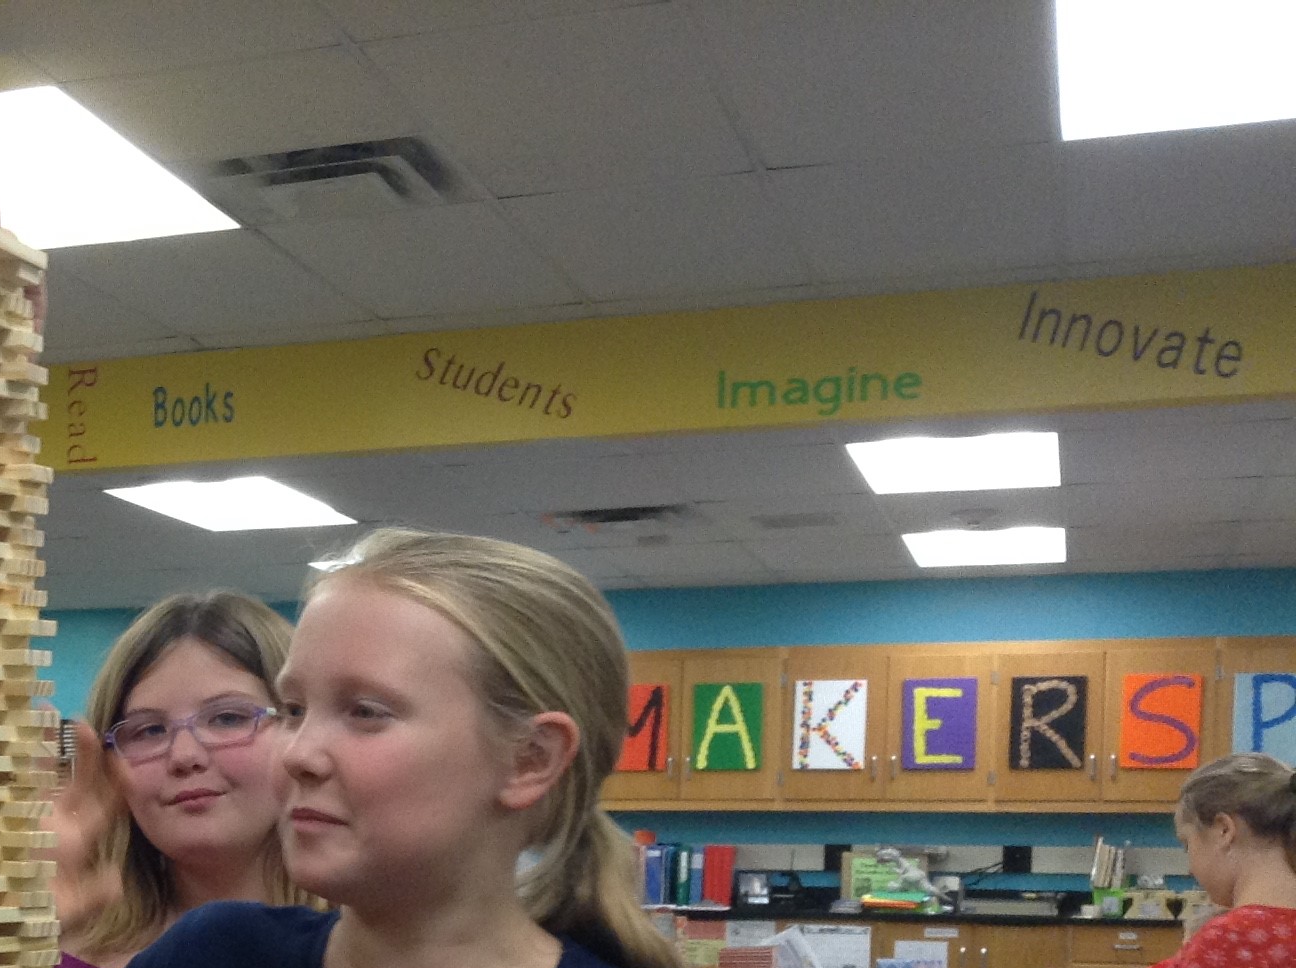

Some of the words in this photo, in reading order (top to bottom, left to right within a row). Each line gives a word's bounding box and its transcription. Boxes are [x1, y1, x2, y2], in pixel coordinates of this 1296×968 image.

[1018, 291, 1244, 379] Innovate
[67, 367, 98, 465] Read
[152, 383, 236, 428] Books
[415, 348, 578, 419] Students
[717, 366, 923, 417] Imagine
